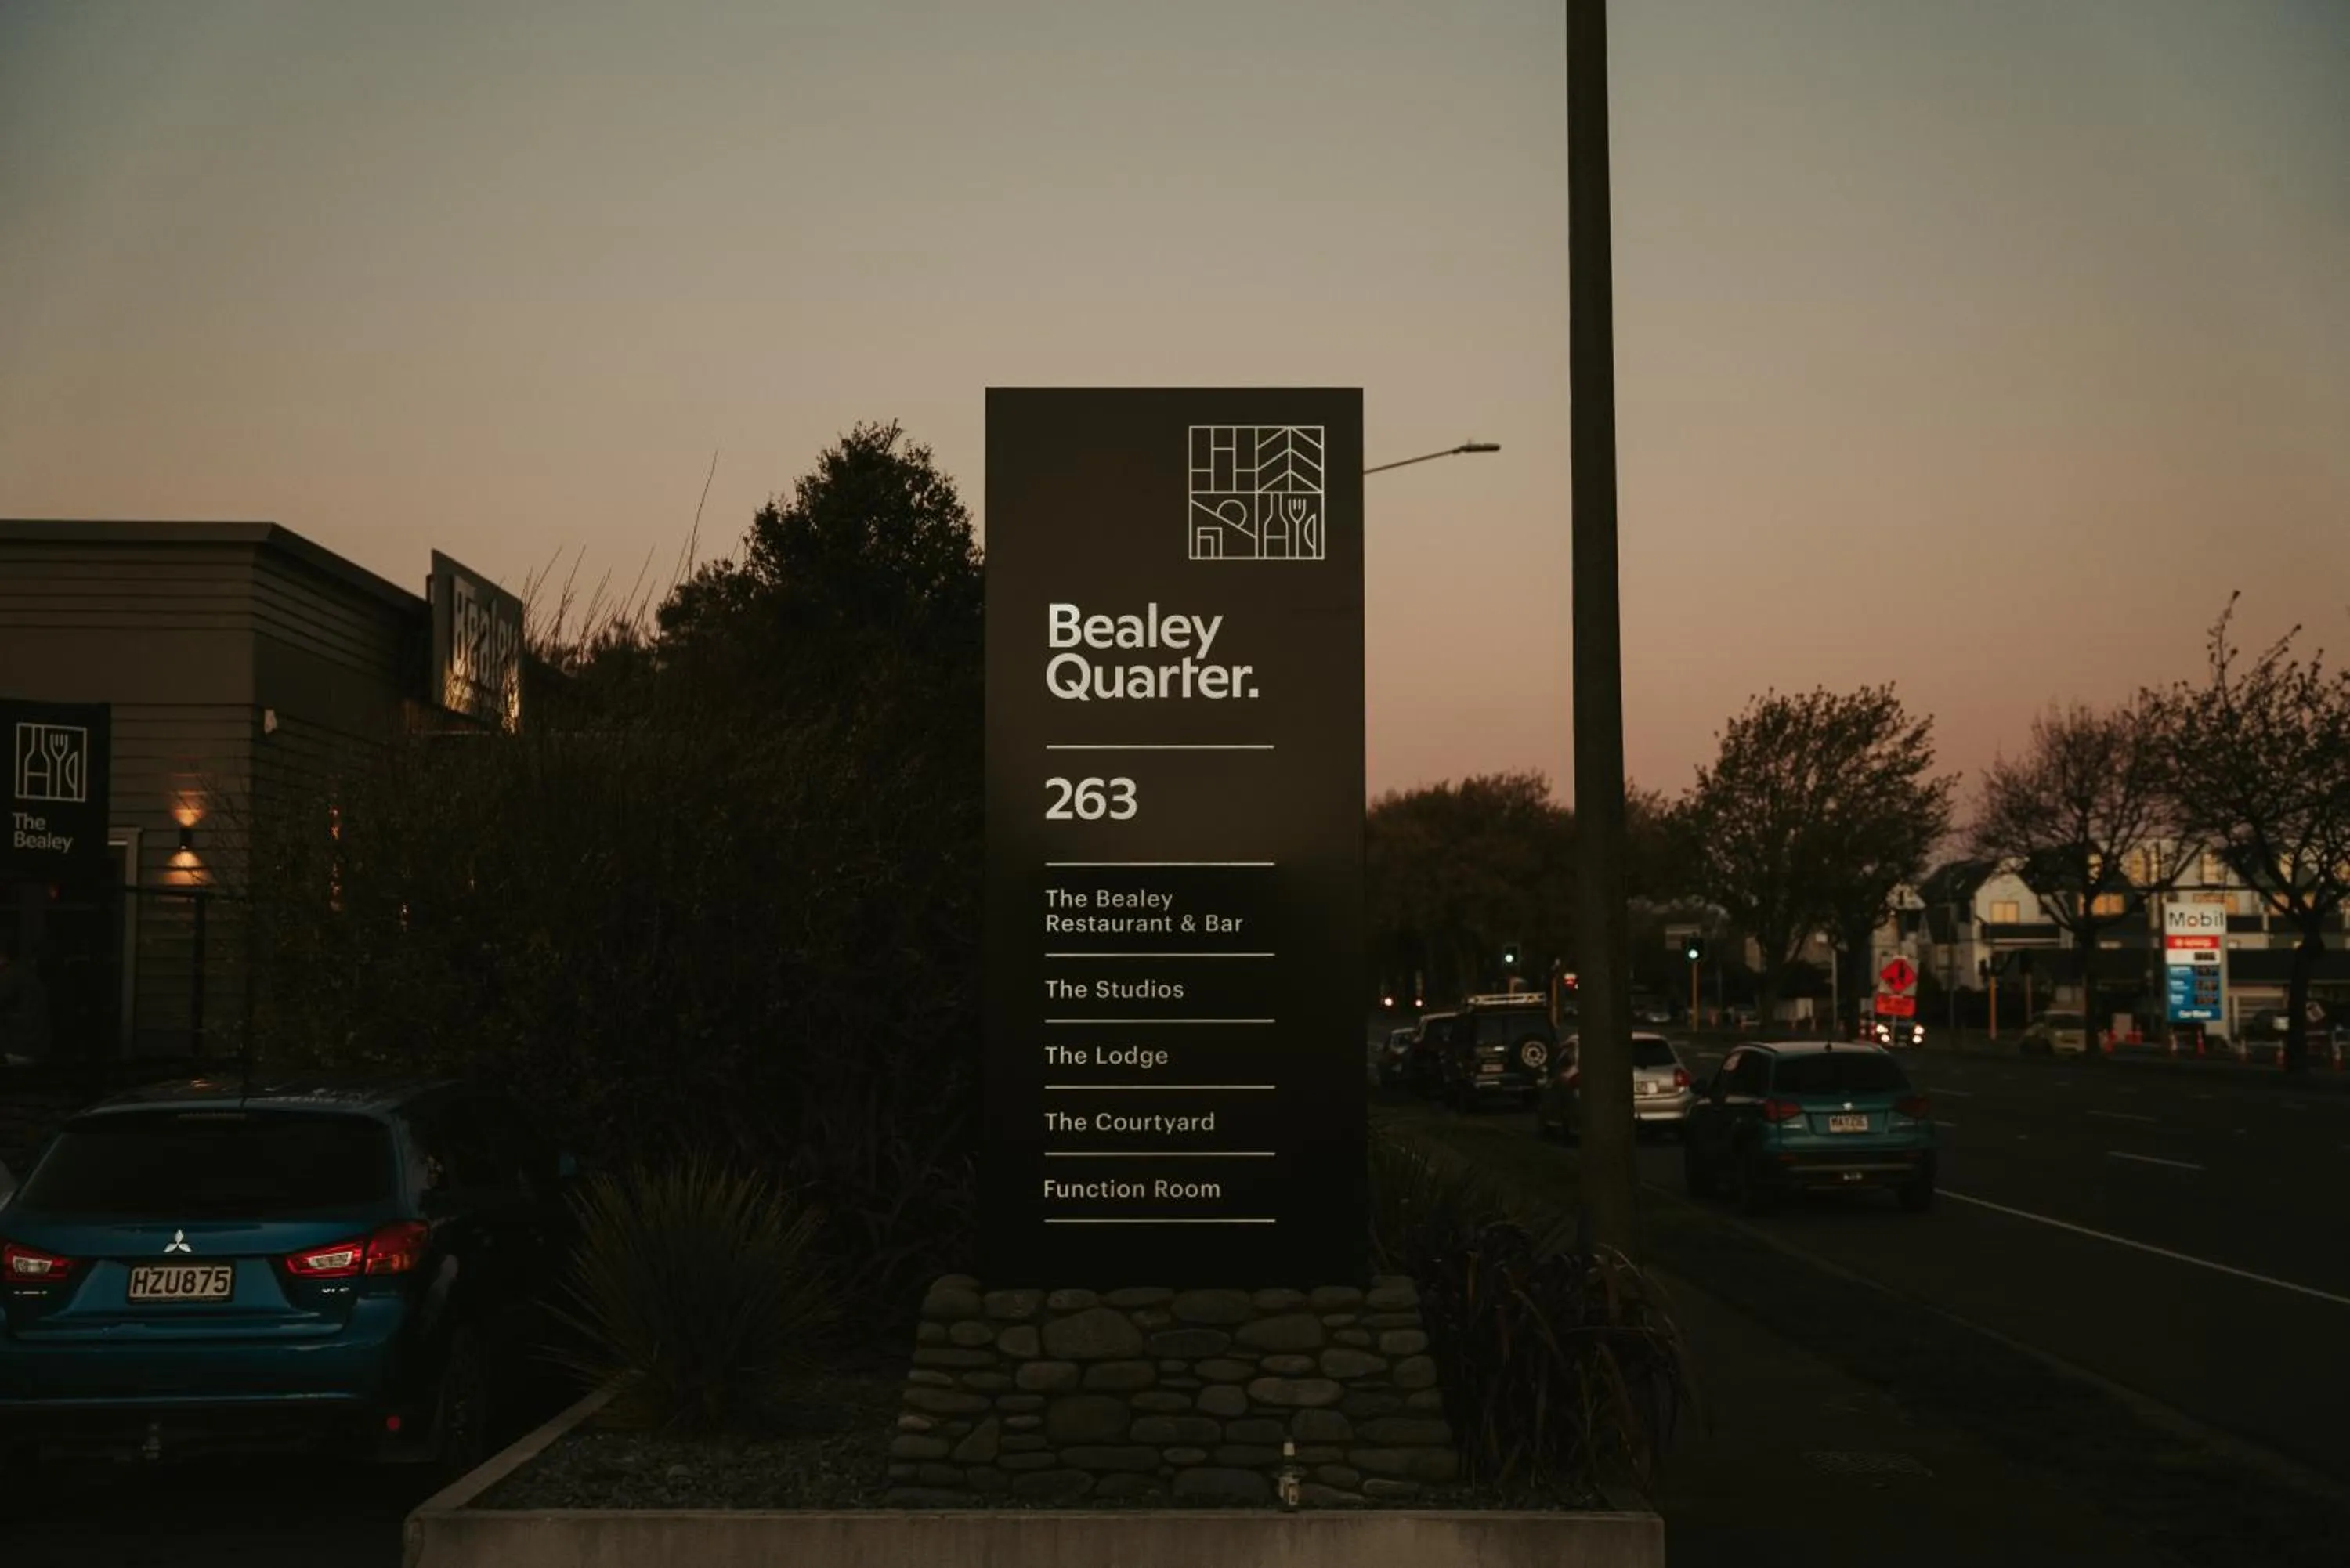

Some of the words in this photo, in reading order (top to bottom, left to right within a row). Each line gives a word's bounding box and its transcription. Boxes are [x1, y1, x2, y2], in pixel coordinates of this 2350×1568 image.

[1048, 602, 1224, 660] Bealey
[1046, 652, 1260, 702] Quarter.
[1044, 777, 1138, 821] 263
[12, 811, 47, 831] The
[13, 830, 74, 854] Bealey
[1046, 889, 1088, 909] The
[1095, 889, 1173, 912] Bealey
[1046, 914, 1173, 933] Restaurant
[1180, 914, 1197, 933] &
[1205, 914, 1243, 933] Bar
[2168, 911, 2225, 927] Mobil
[1045, 979, 1088, 999] The
[1095, 979, 1184, 999] Studios
[1044, 1046, 1087, 1065] The
[1095, 1046, 1169, 1069] Lodge
[1044, 1111, 1087, 1132] The
[1095, 1111, 1215, 1135] Courtyard
[1043, 1179, 1145, 1198] Function
[1154, 1180, 1221, 1198] Room
[132, 1270, 229, 1294] HZU875
